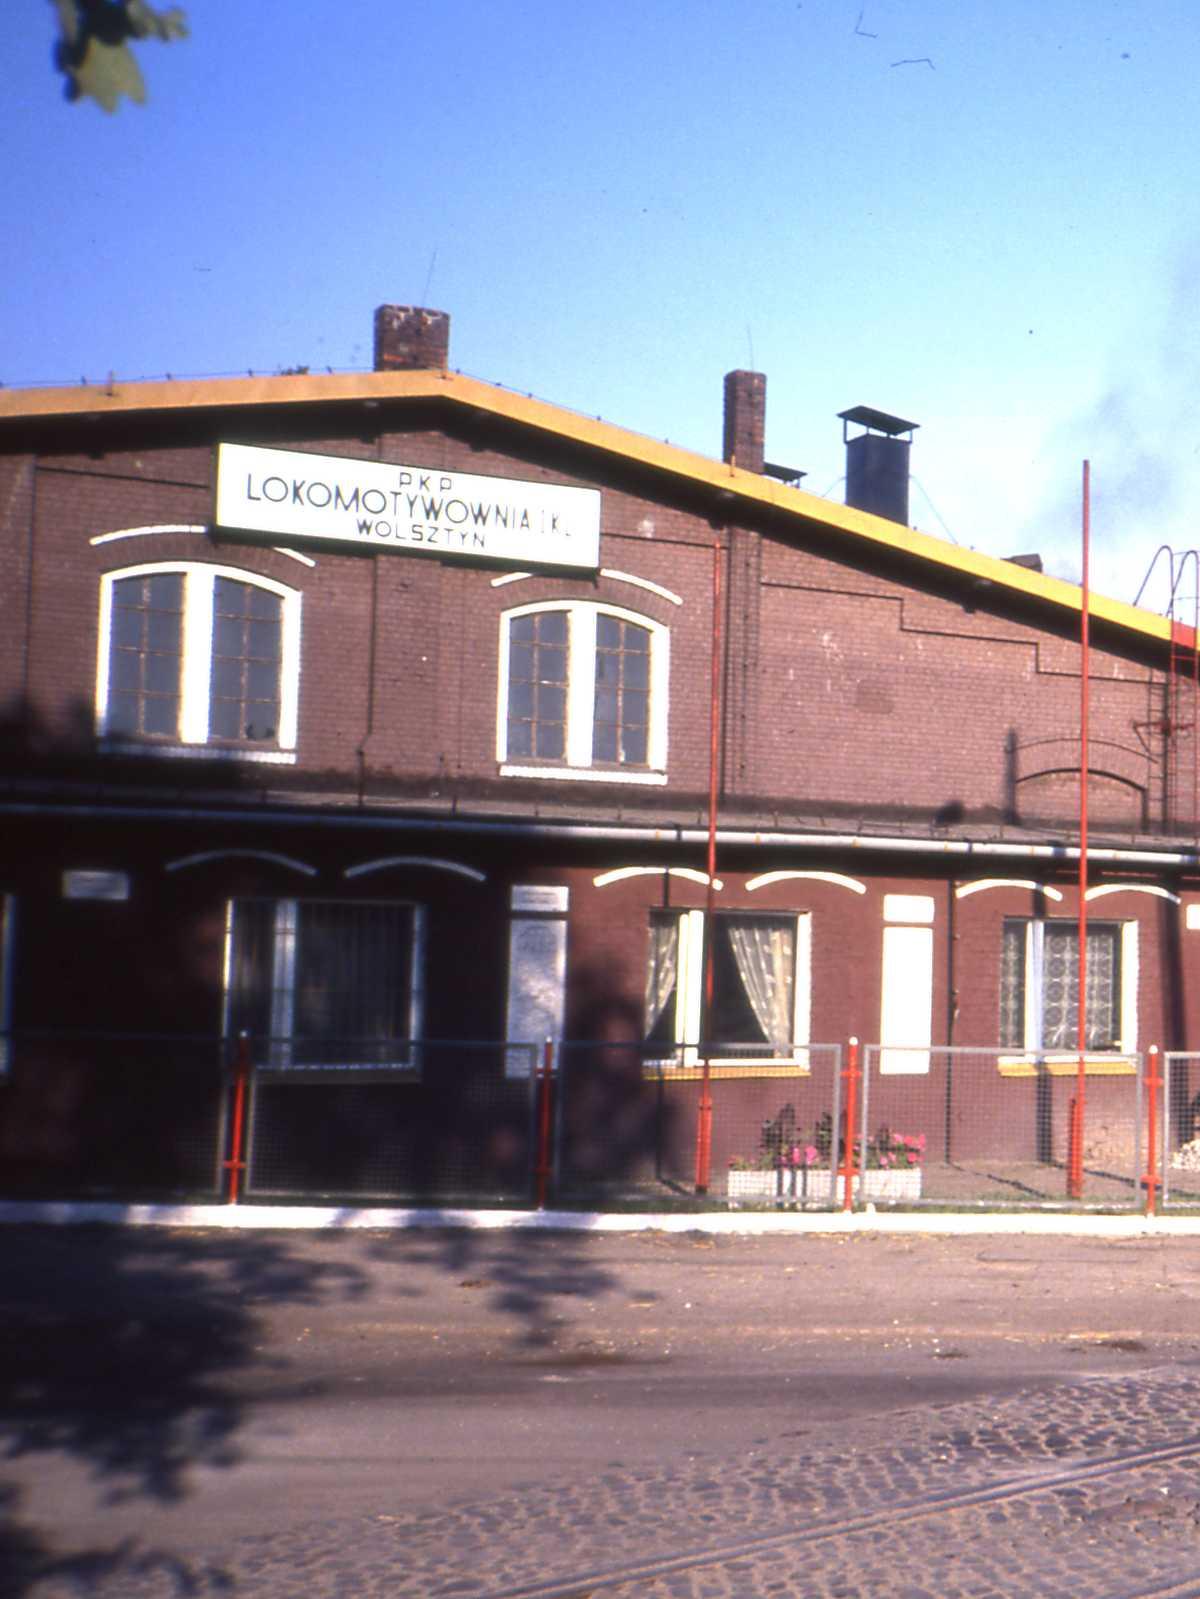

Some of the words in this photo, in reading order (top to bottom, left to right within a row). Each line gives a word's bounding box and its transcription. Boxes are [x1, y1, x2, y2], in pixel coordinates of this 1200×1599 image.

[400, 472, 452, 491] PKP
[247, 474, 530, 529] LOKOMOTYWOWNIA
[357, 519, 486, 548] WOLSZTYN
